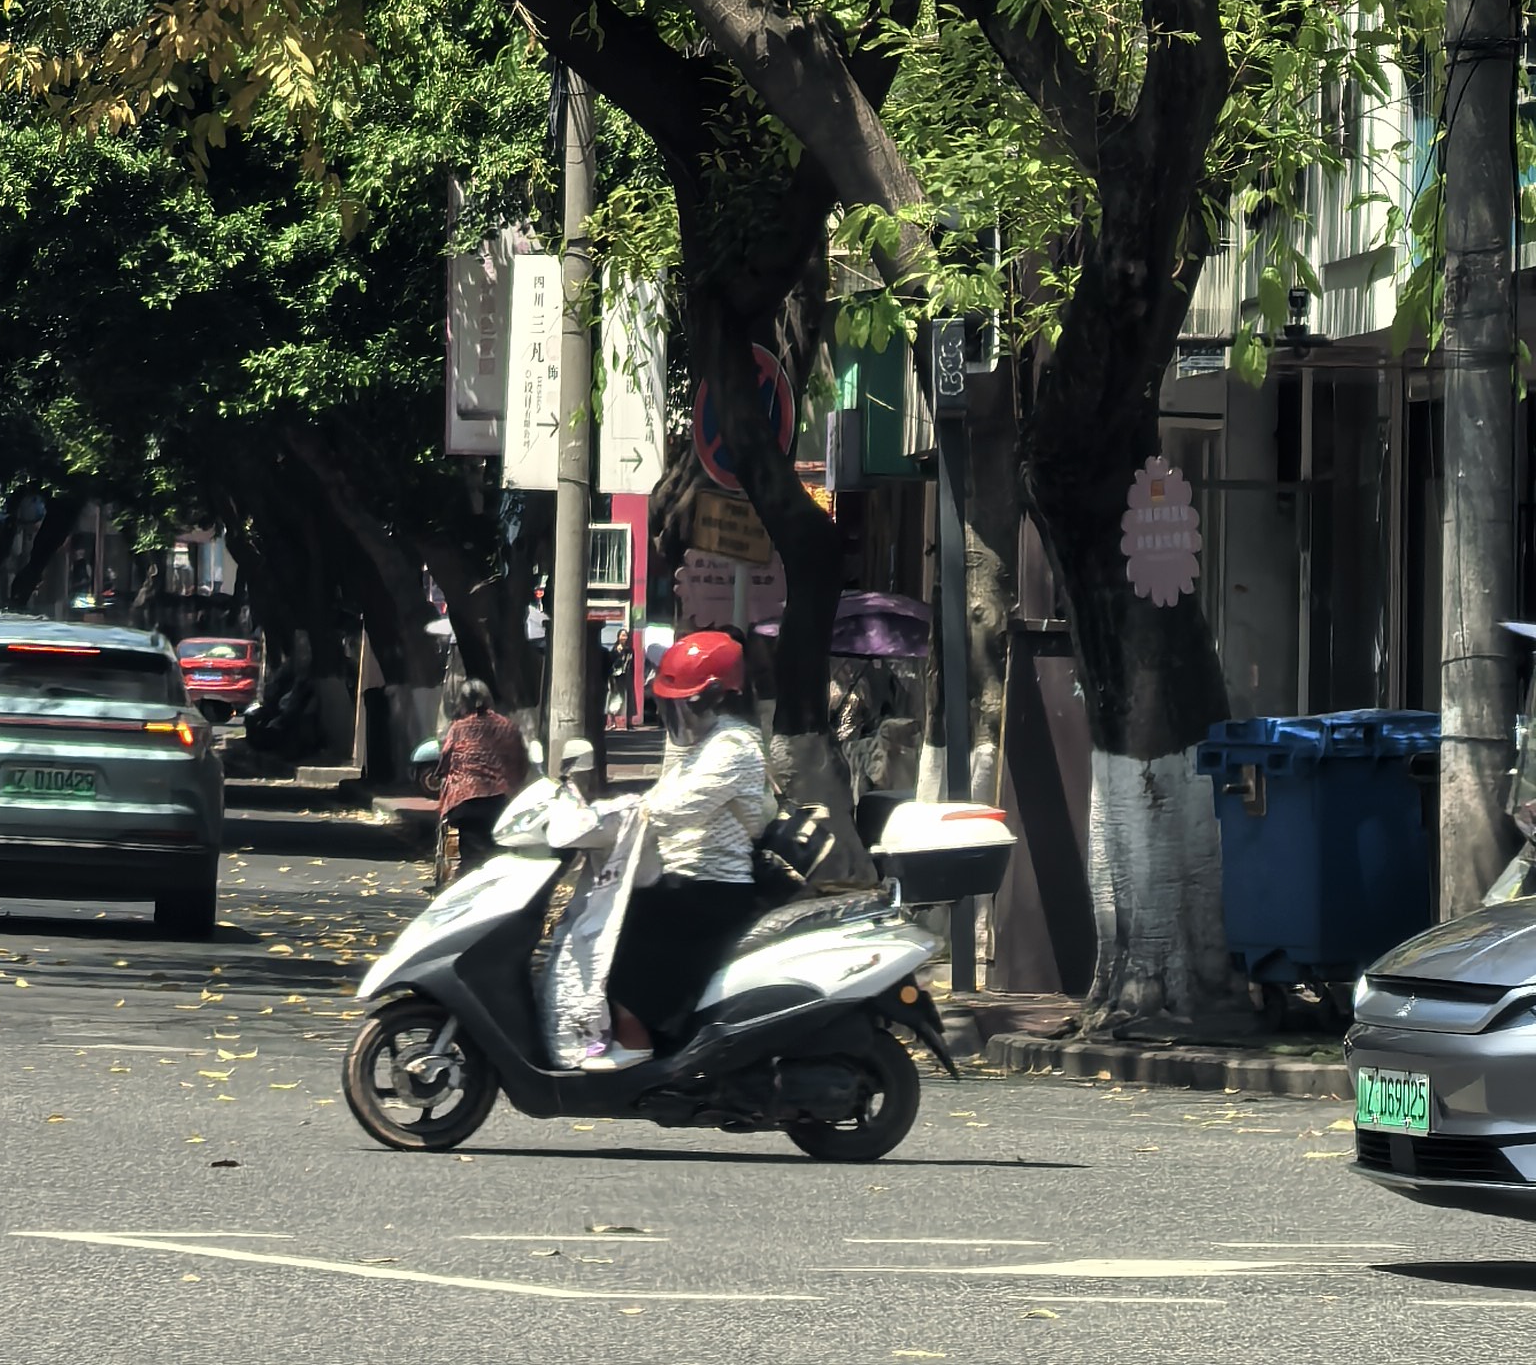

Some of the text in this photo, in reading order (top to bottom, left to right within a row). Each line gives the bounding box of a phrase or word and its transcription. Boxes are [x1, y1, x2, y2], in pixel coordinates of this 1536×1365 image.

[530, 276, 545, 363] 四川三凡
[5, 769, 95, 792] ZD10429
